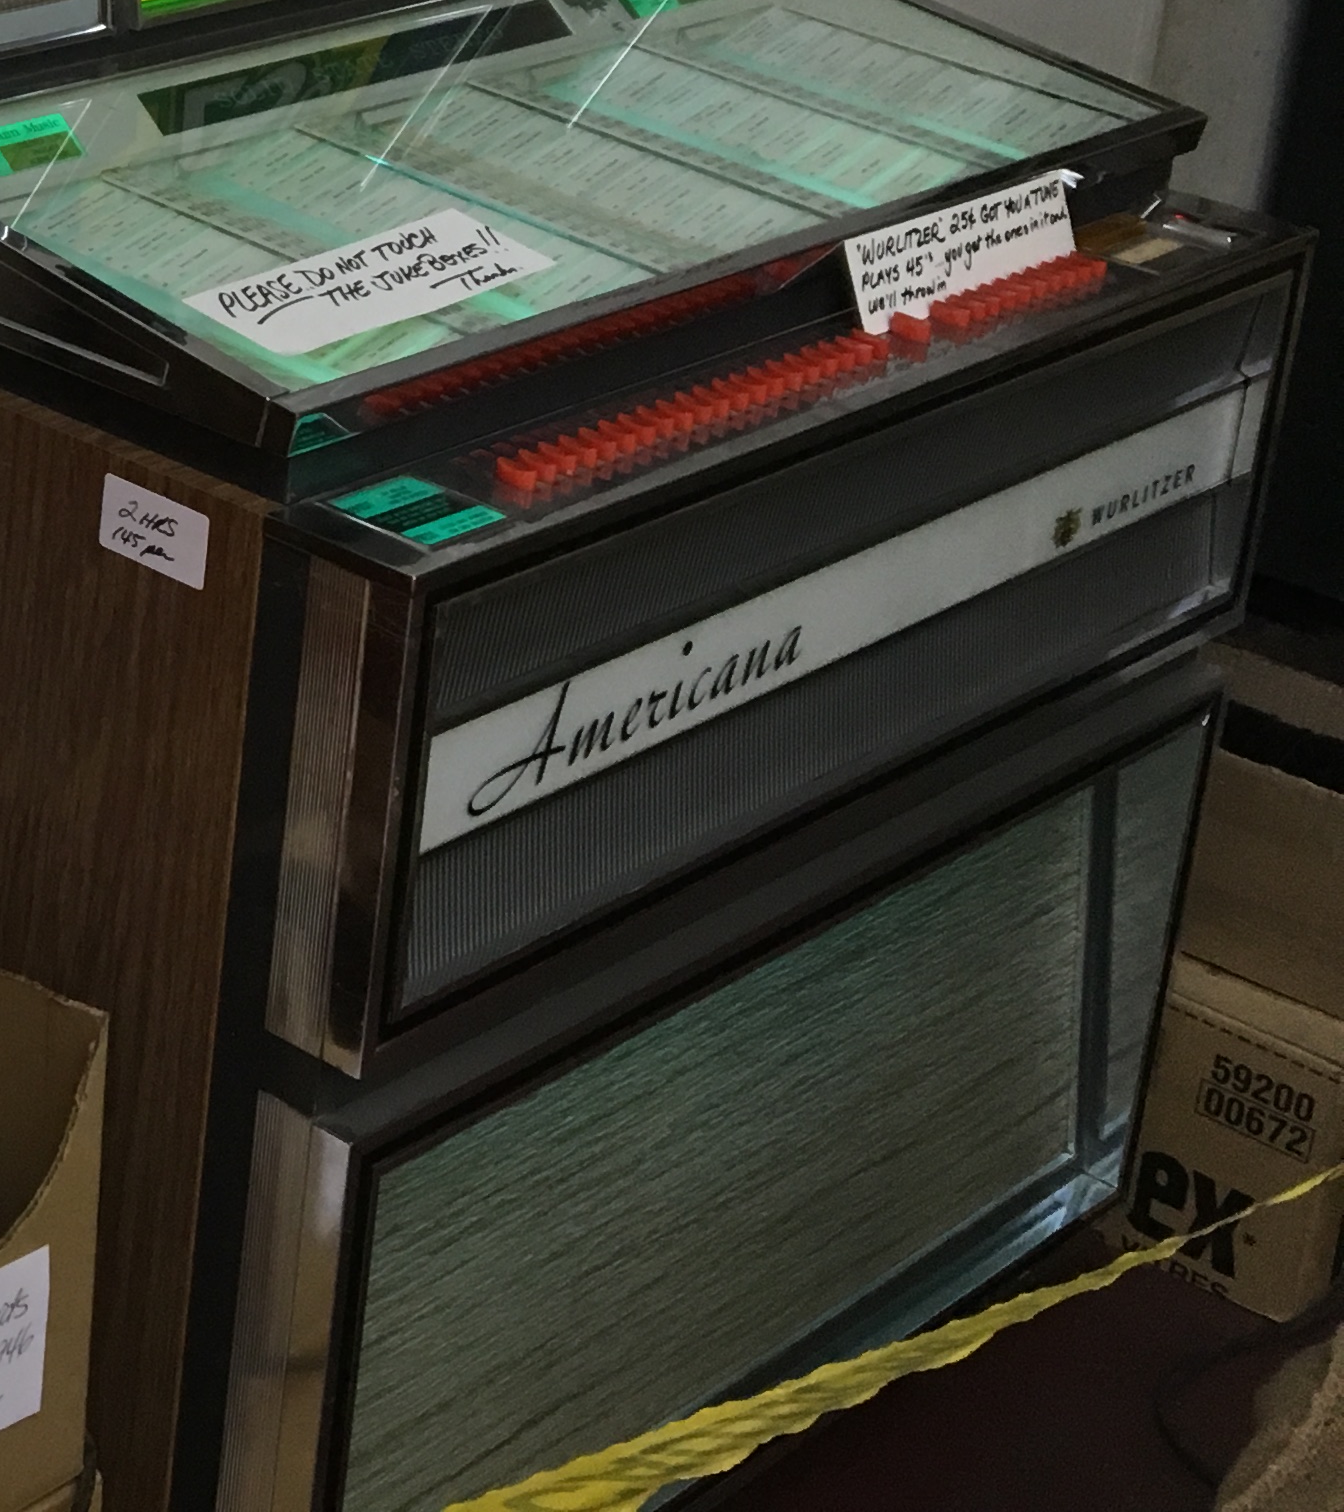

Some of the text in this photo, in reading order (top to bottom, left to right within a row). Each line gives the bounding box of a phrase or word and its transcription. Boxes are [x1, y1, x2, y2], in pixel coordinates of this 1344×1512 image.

[23, 118, 60, 133] Music
[1003, 194, 1024, 220] YOU
[1030, 179, 1060, 204] TUNE
[218, 226, 439, 318] PLEASE DO NOT TOUCH
[861, 265, 900, 293] PLAYS
[944, 247, 963, 278] you
[964, 236, 983, 271] get
[984, 228, 1003, 250] the
[318, 280, 371, 307] THE
[118, 500, 138, 522] 2
[1092, 463, 1196, 527] WURLITZER
[468, 625, 803, 817] Americana
[1211, 1054, 1316, 1122] 59200
[1204, 1087, 1308, 1156] 00672
